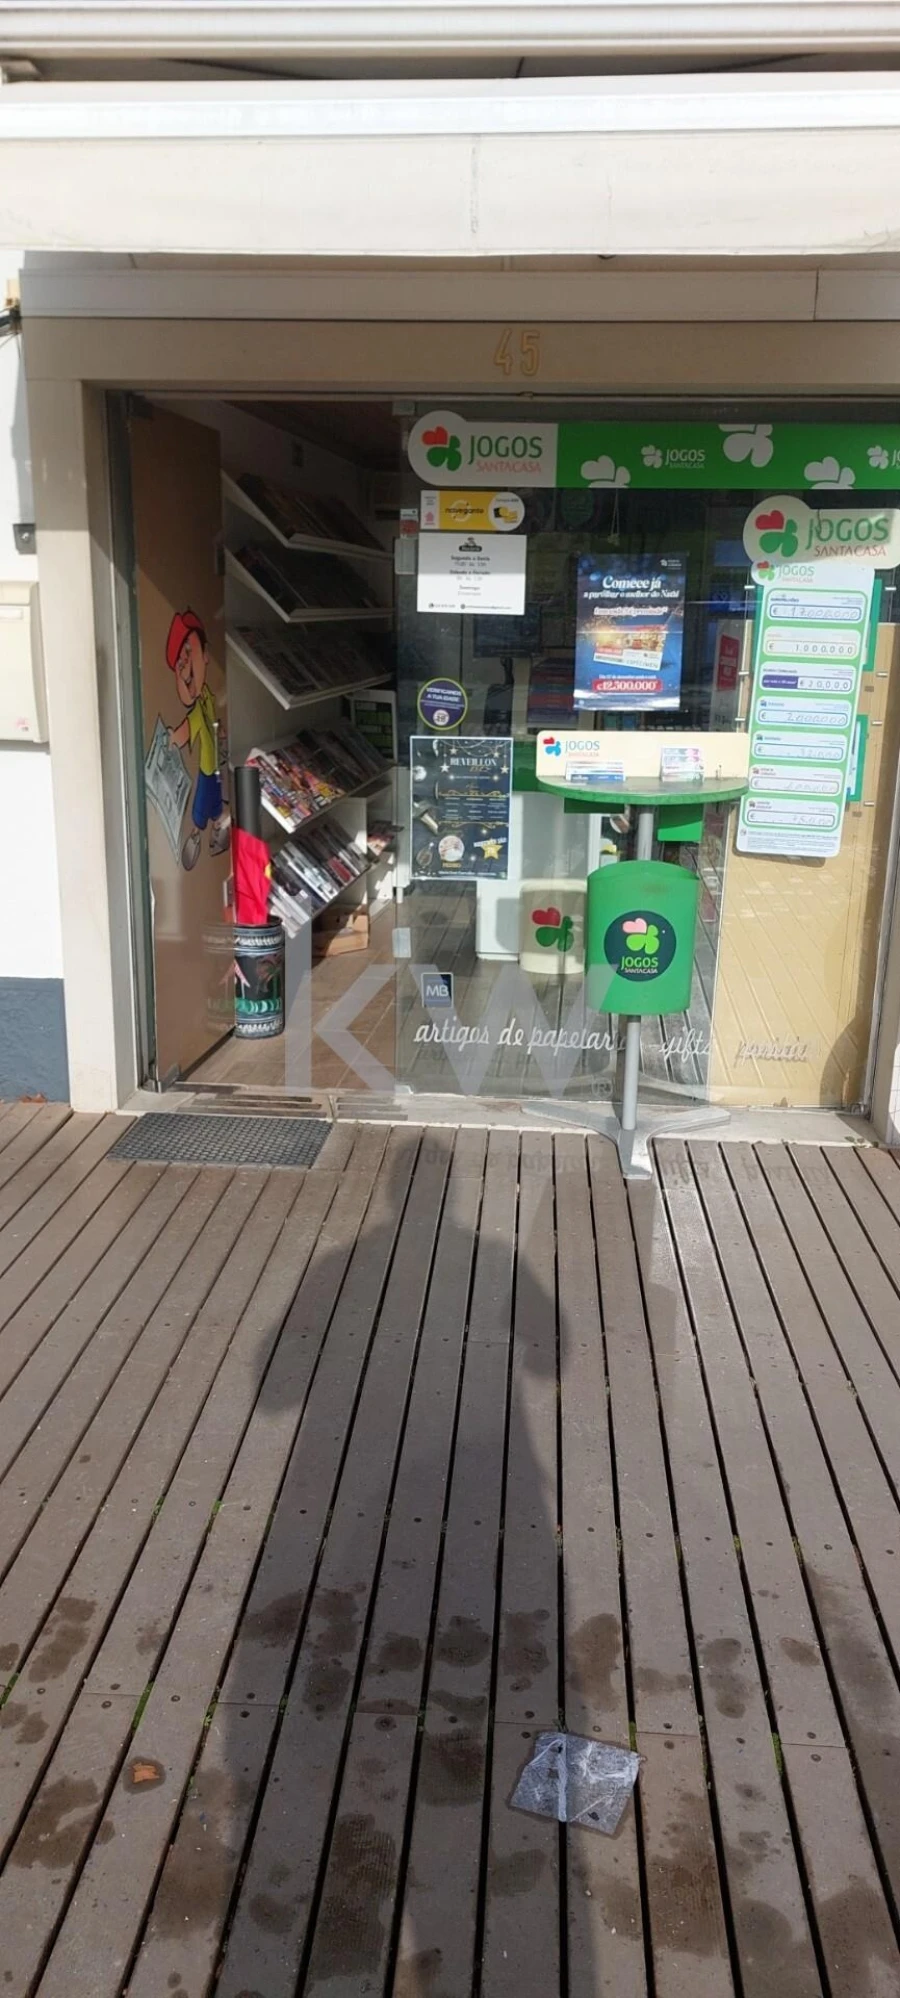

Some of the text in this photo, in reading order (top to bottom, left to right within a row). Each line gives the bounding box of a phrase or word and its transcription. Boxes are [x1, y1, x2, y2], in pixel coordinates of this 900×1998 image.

[493, 328, 541, 377] 45
[467, 435, 543, 465] JOGOS
[665, 448, 706, 466] JOGOS
[476, 460, 542, 473] SANTACASA
[805, 518, 889, 550] JOGOS
[814, 545, 887, 557] SANTACASA
[777, 565, 815, 579] JOGOS
[602, 575, 662, 591] Comece já
[565, 740, 600, 754] JOGOS
[620, 956, 659, 971] JOGOS
[426, 985, 449, 997] MB
[413, 1016, 489, 1052] artigos
[497, 1018, 524, 1046] de
